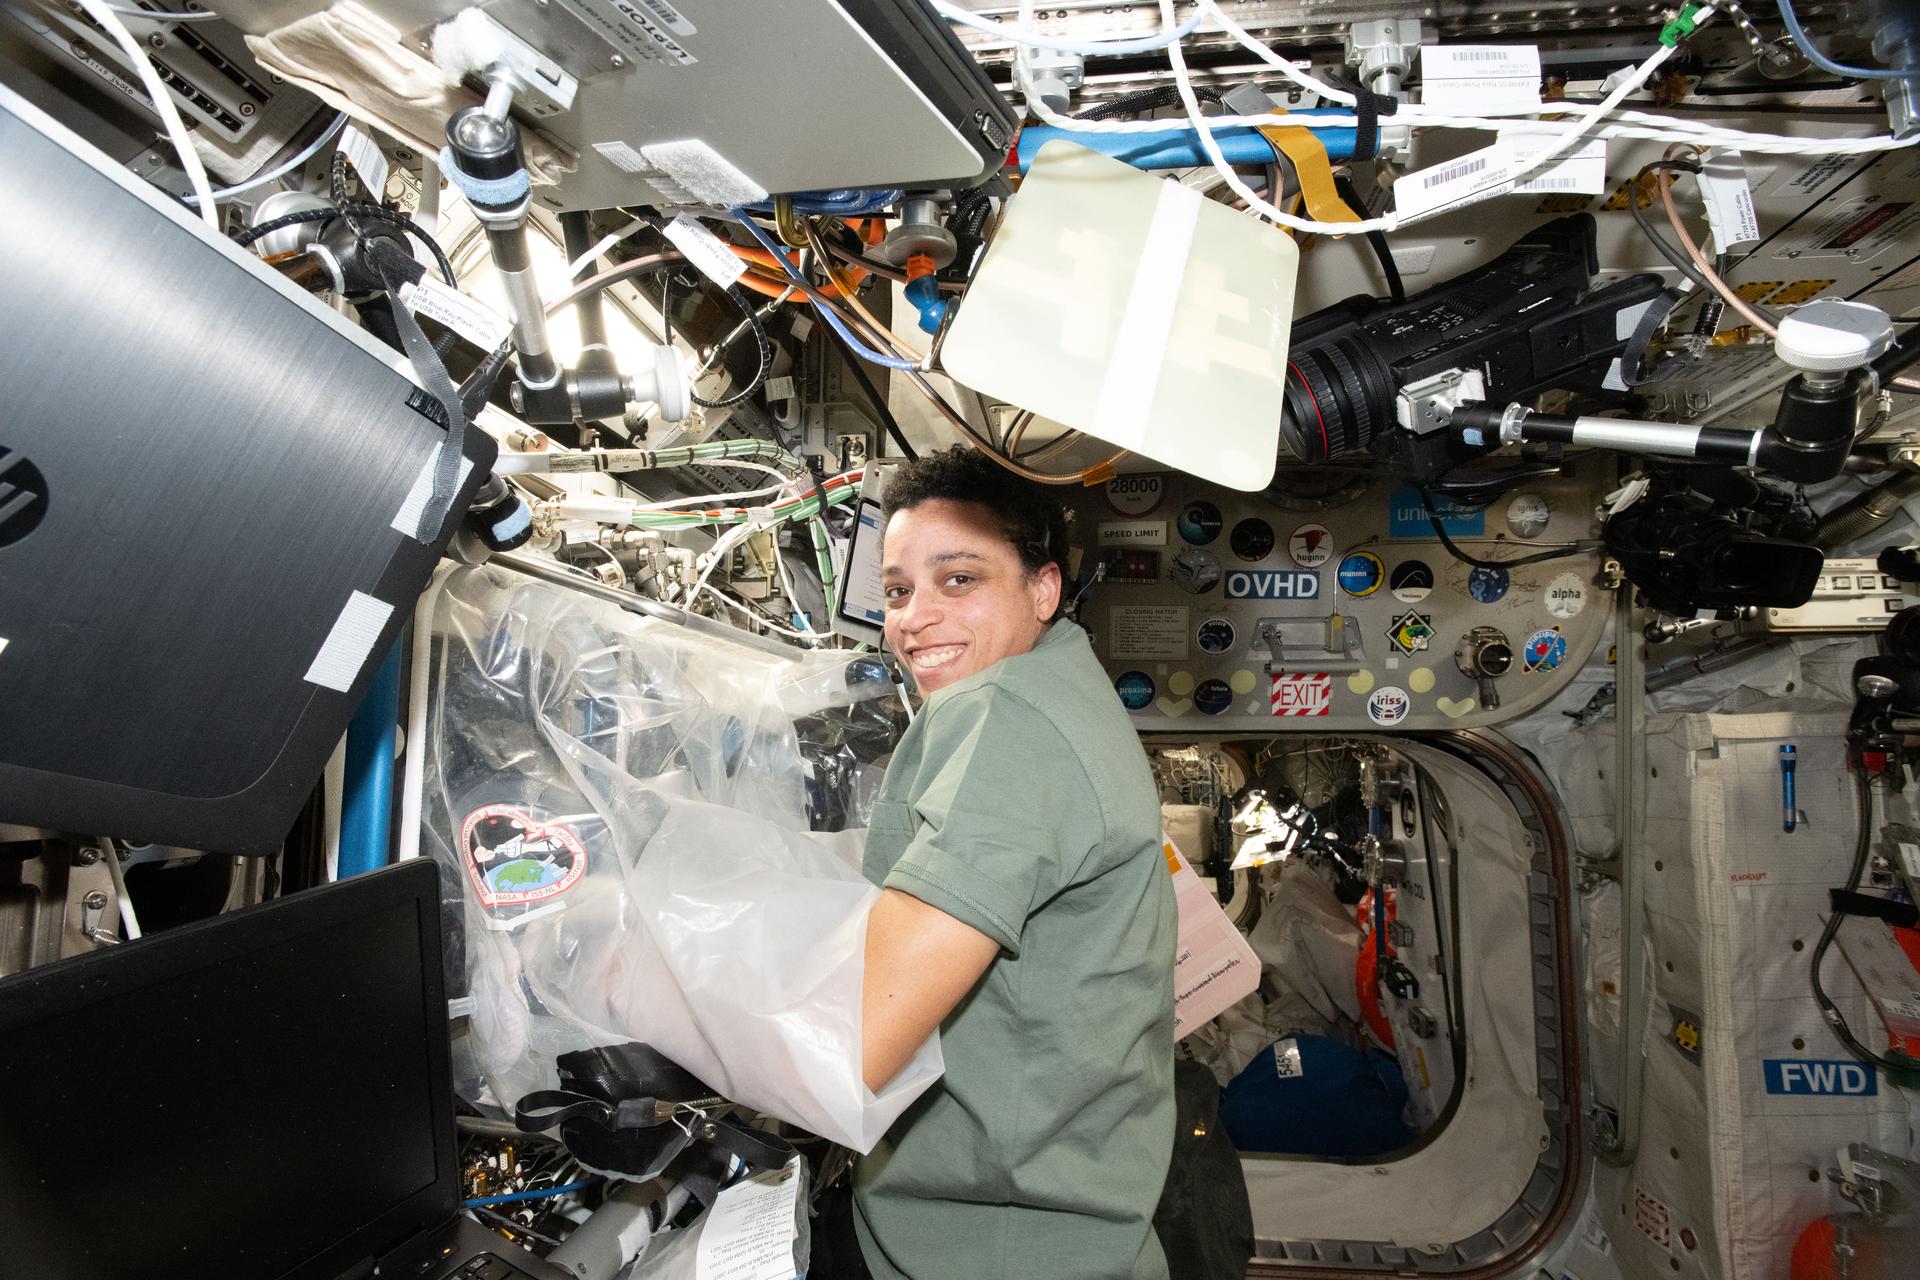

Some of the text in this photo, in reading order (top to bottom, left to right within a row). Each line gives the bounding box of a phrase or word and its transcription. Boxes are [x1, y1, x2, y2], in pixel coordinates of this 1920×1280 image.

[618, 4, 688, 59] LAPTOP
[400, 197, 416, 211] MODE
[1735, 232, 1744, 241] P1
[416, 286, 429, 296] P1
[413, 294, 428, 304] USB
[418, 302, 434, 314] USB
[1110, 478, 1159, 493] 28000
[1104, 530, 1133, 538] SPEED
[1296, 553, 1326, 563] huginn
[1227, 572, 1318, 598] OVHD
[1552, 588, 1582, 600] alpha
[1528, 631, 1557, 650] principia
[1120, 686, 1152, 696] proxima
[1280, 684, 1322, 706] EXIT
[1376, 695, 1402, 706] iriss
[531, 886, 556, 898] ISS-NL
[1780, 1063, 1868, 1094] FWD
